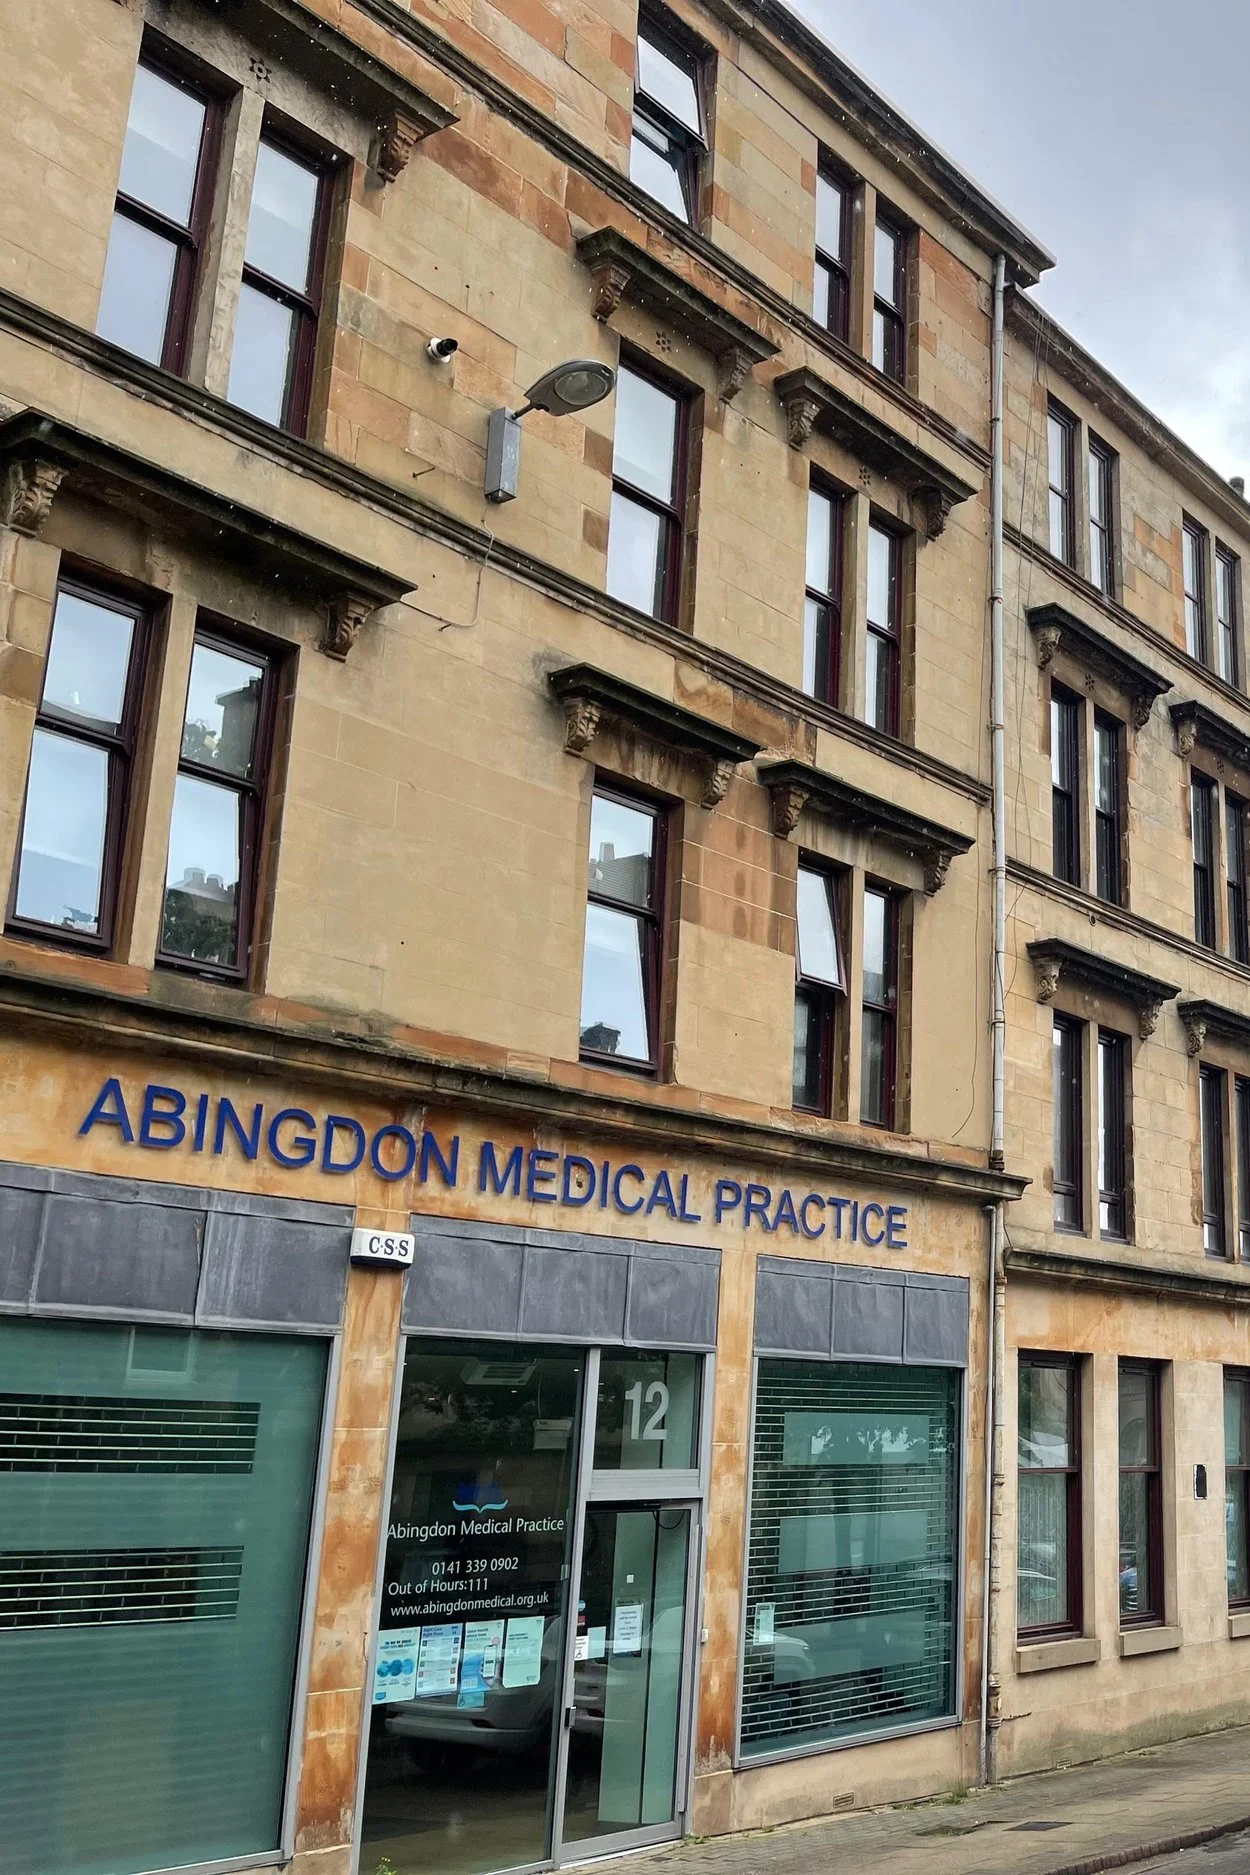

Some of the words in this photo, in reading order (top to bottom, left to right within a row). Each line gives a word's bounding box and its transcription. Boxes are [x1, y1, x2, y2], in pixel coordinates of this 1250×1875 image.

[78, 1077, 460, 1187] ABINGDON
[479, 1141, 702, 1223] MEDICAL
[715, 1179, 908, 1248] PRACTICE
[625, 1381, 670, 1440] 12
[387, 1521, 456, 1542] Abingdon
[460, 1517, 512, 1535] Medical
[516, 1517, 564, 1532] Practice
[432, 1561, 460, 1575] 0141
[465, 1560, 487, 1573] 339
[490, 1557, 519, 1571] 0902
[388, 1582, 412, 1595] Out
[415, 1580, 428, 1593] of
[391, 1592, 549, 1616] www.abingdonmedical.org.uk
